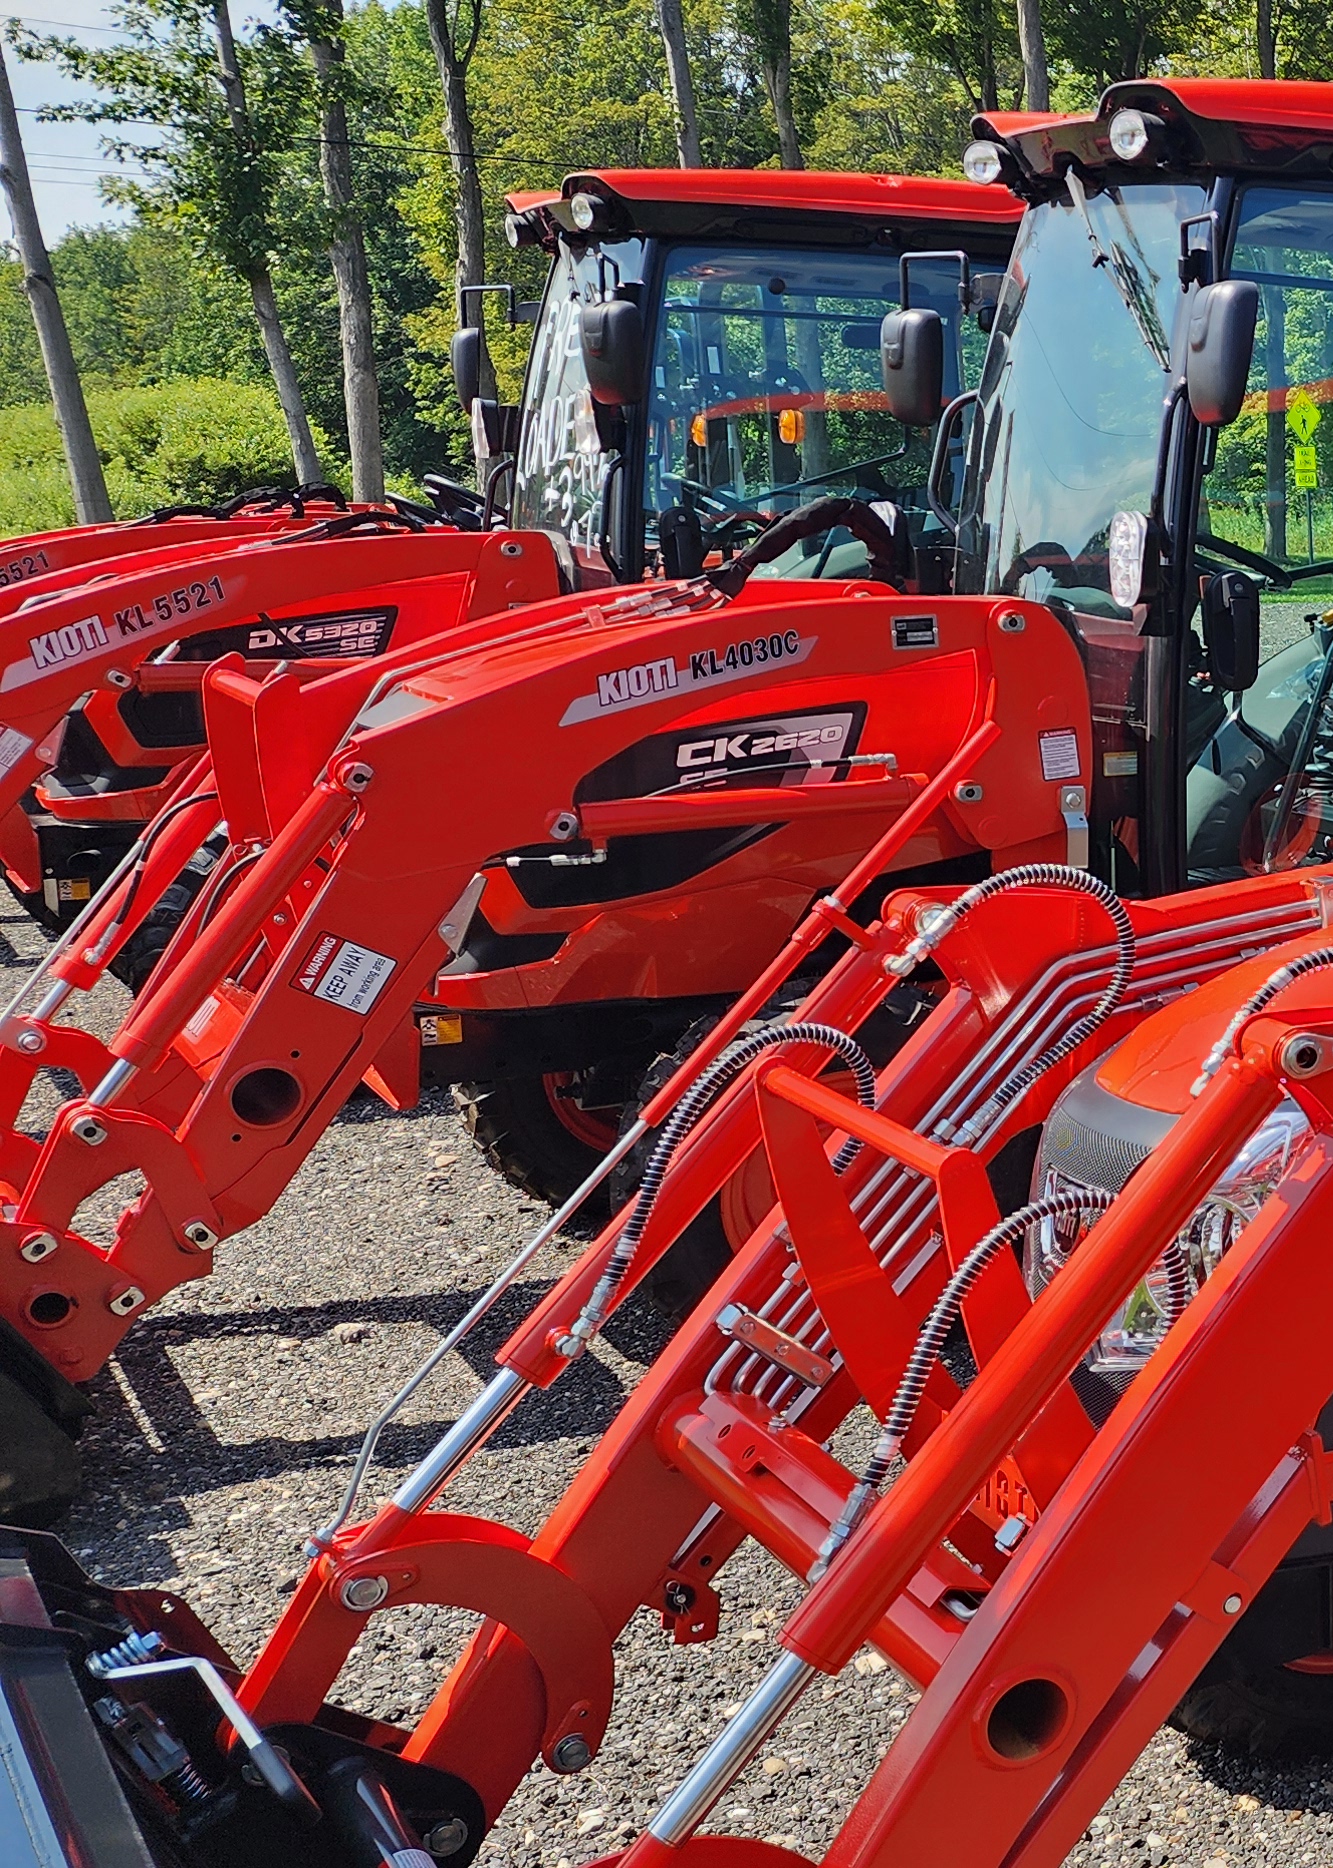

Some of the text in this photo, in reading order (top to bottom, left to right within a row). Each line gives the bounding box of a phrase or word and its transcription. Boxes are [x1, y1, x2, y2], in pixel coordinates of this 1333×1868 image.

[517, 393, 578, 491] LOADE
[28, 615, 109, 670] KIOTI
[339, 635, 376, 651] SE
[597, 629, 799, 707] KIOTI KL4030C
[304, 936, 338, 977] WARNING
[322, 946, 366, 1001] KEEP AWAY
[347, 957, 387, 1009] from working area
